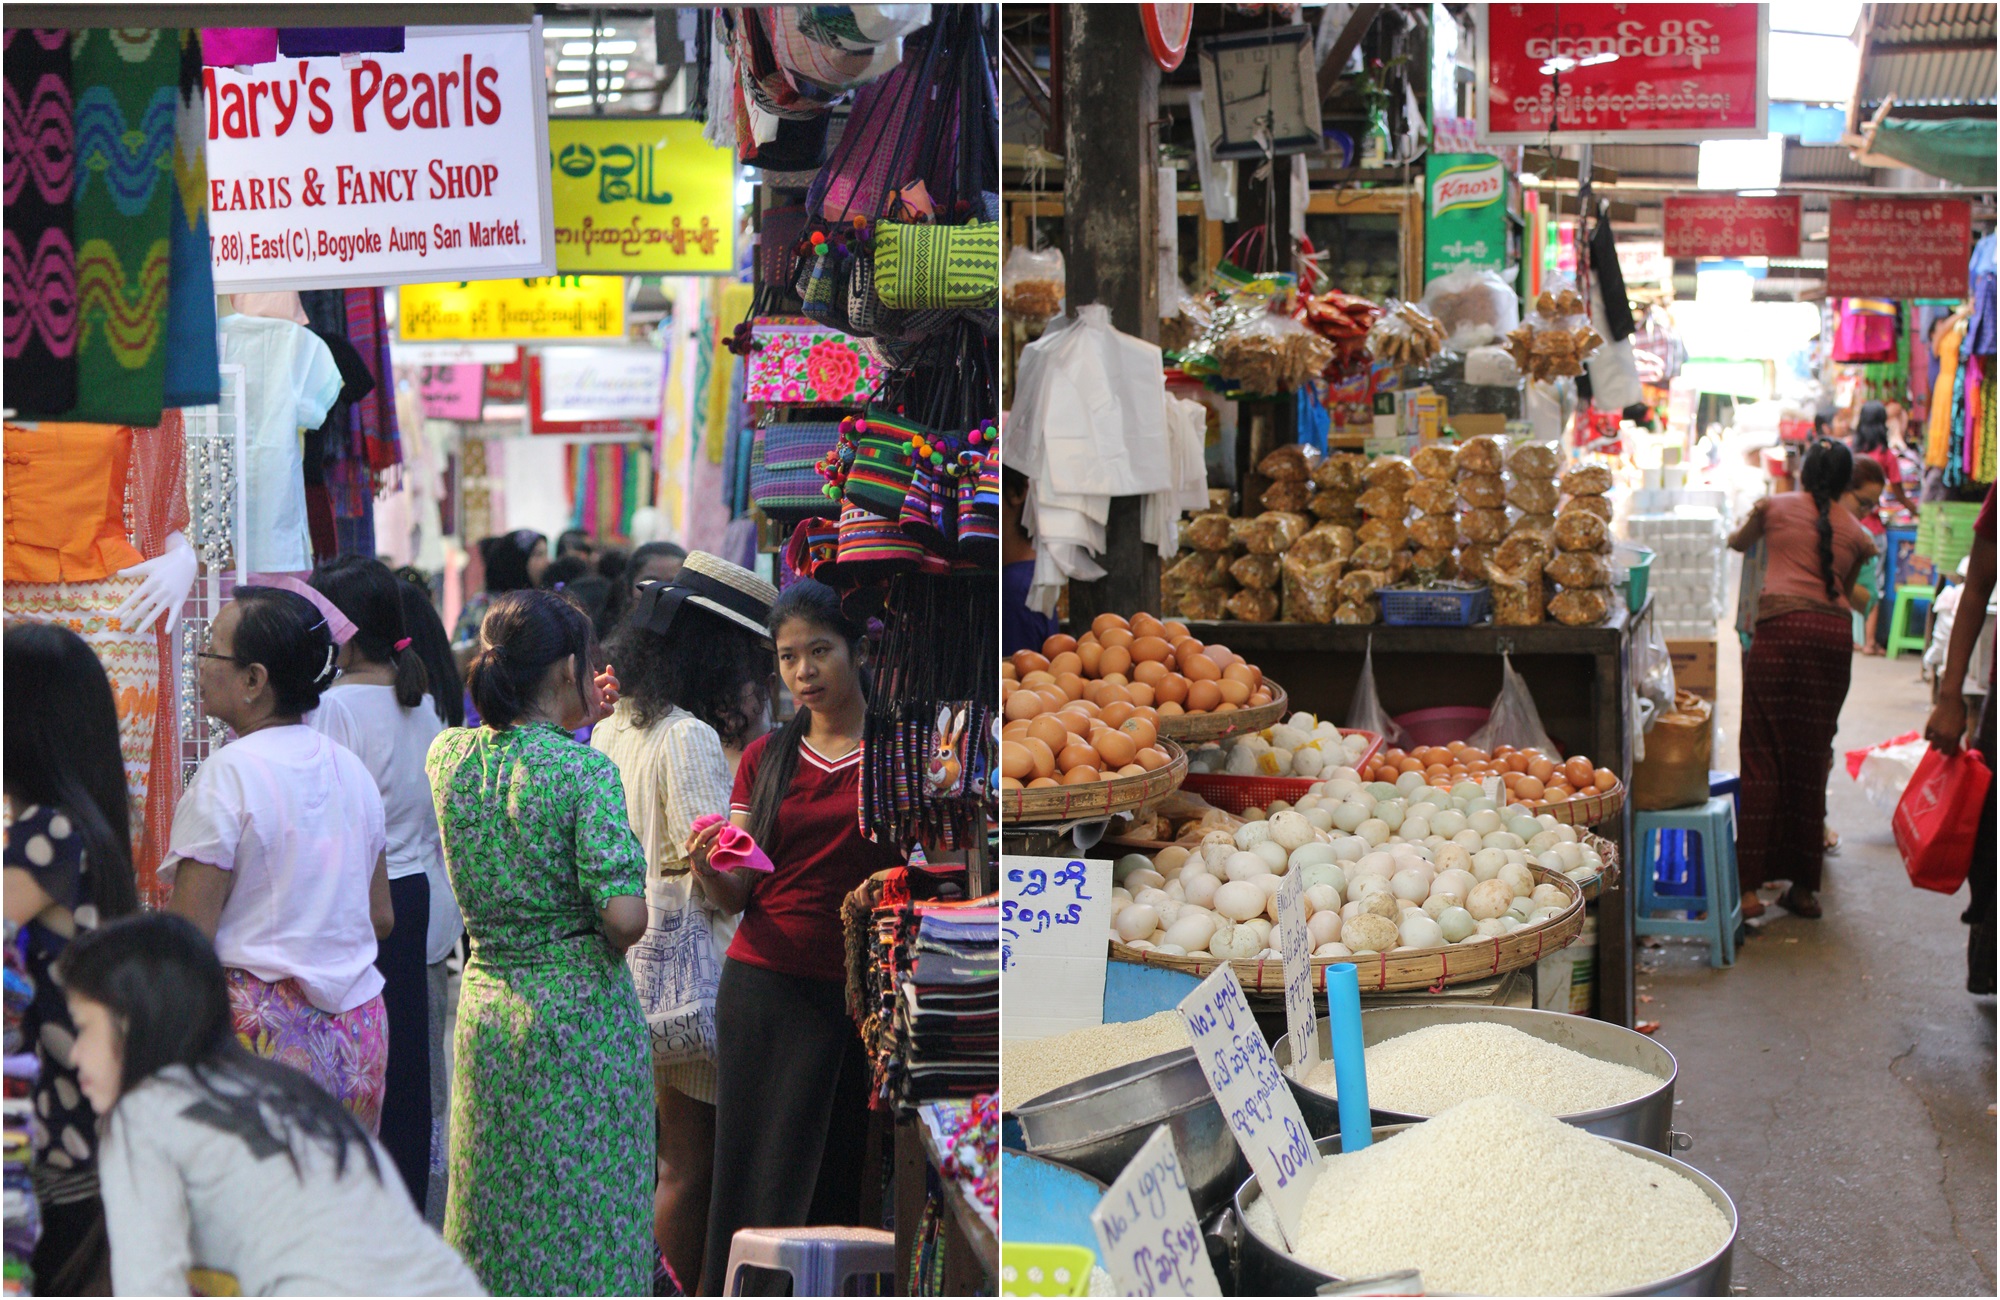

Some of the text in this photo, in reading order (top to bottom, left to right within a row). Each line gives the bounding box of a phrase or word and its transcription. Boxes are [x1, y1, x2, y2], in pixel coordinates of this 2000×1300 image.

[351, 54, 501, 132] Pearls
[302, 167, 326, 207] &
[336, 165, 418, 205] FANCY
[428, 159, 498, 199] SHOP
[1437, 177, 1498, 202] Knorr
[389, 226, 427, 257] Aung
[433, 223, 462, 249] San
[467, 218, 526, 248] Market.
